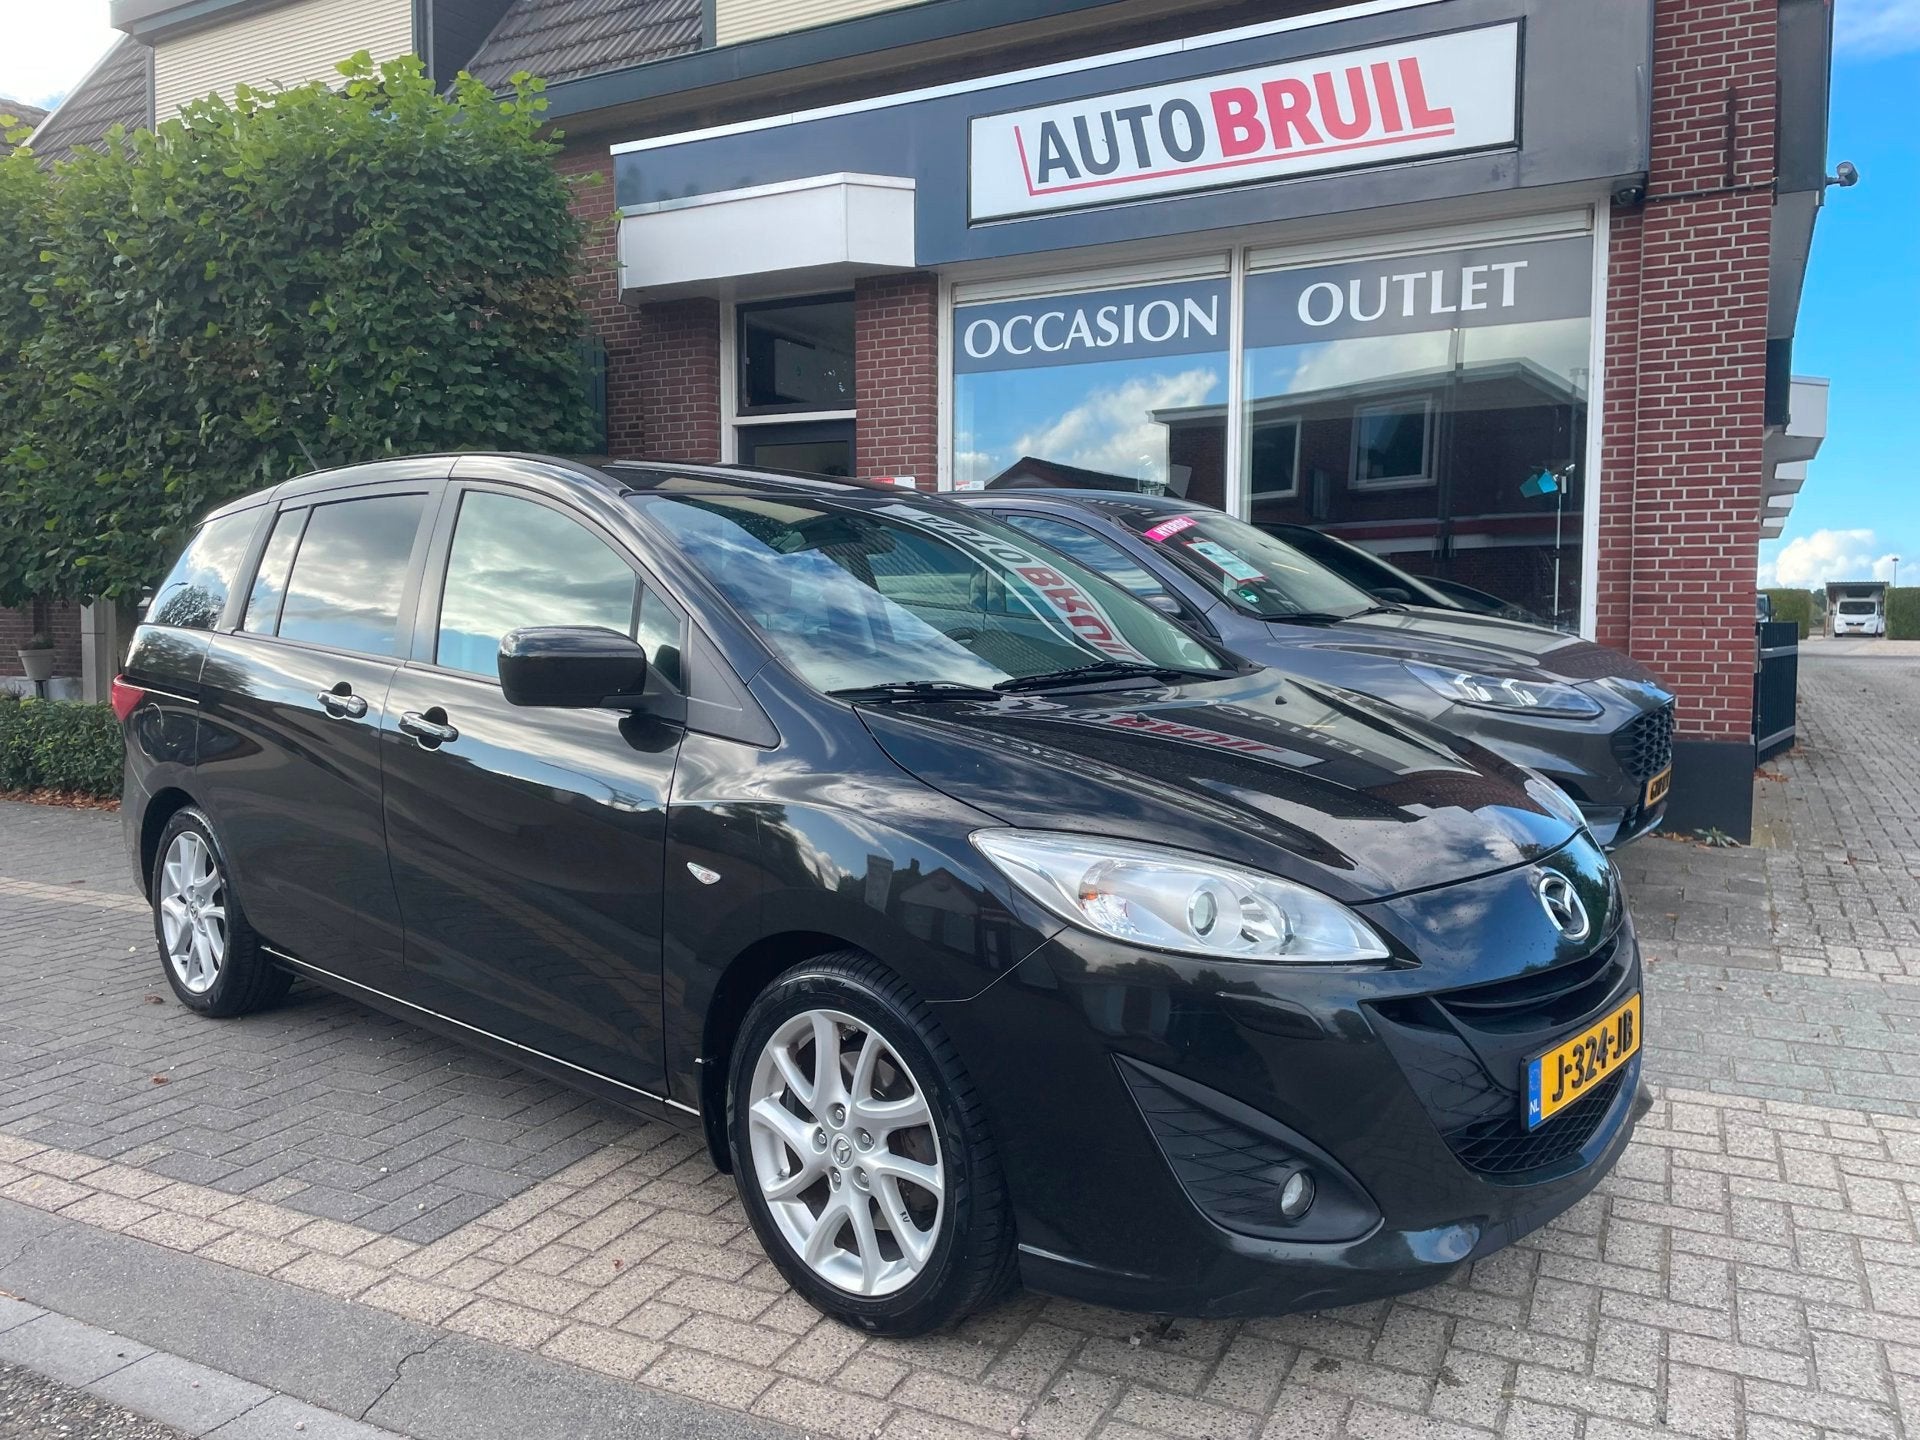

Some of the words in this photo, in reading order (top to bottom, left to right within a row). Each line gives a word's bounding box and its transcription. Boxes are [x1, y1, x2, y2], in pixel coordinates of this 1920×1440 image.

[963, 295, 1218, 358] OCCASION
[1297, 260, 1528, 326] OUTLET
[1552, 1009, 1633, 1102] J-324-JB
[1530, 1098, 1540, 1116] NL
